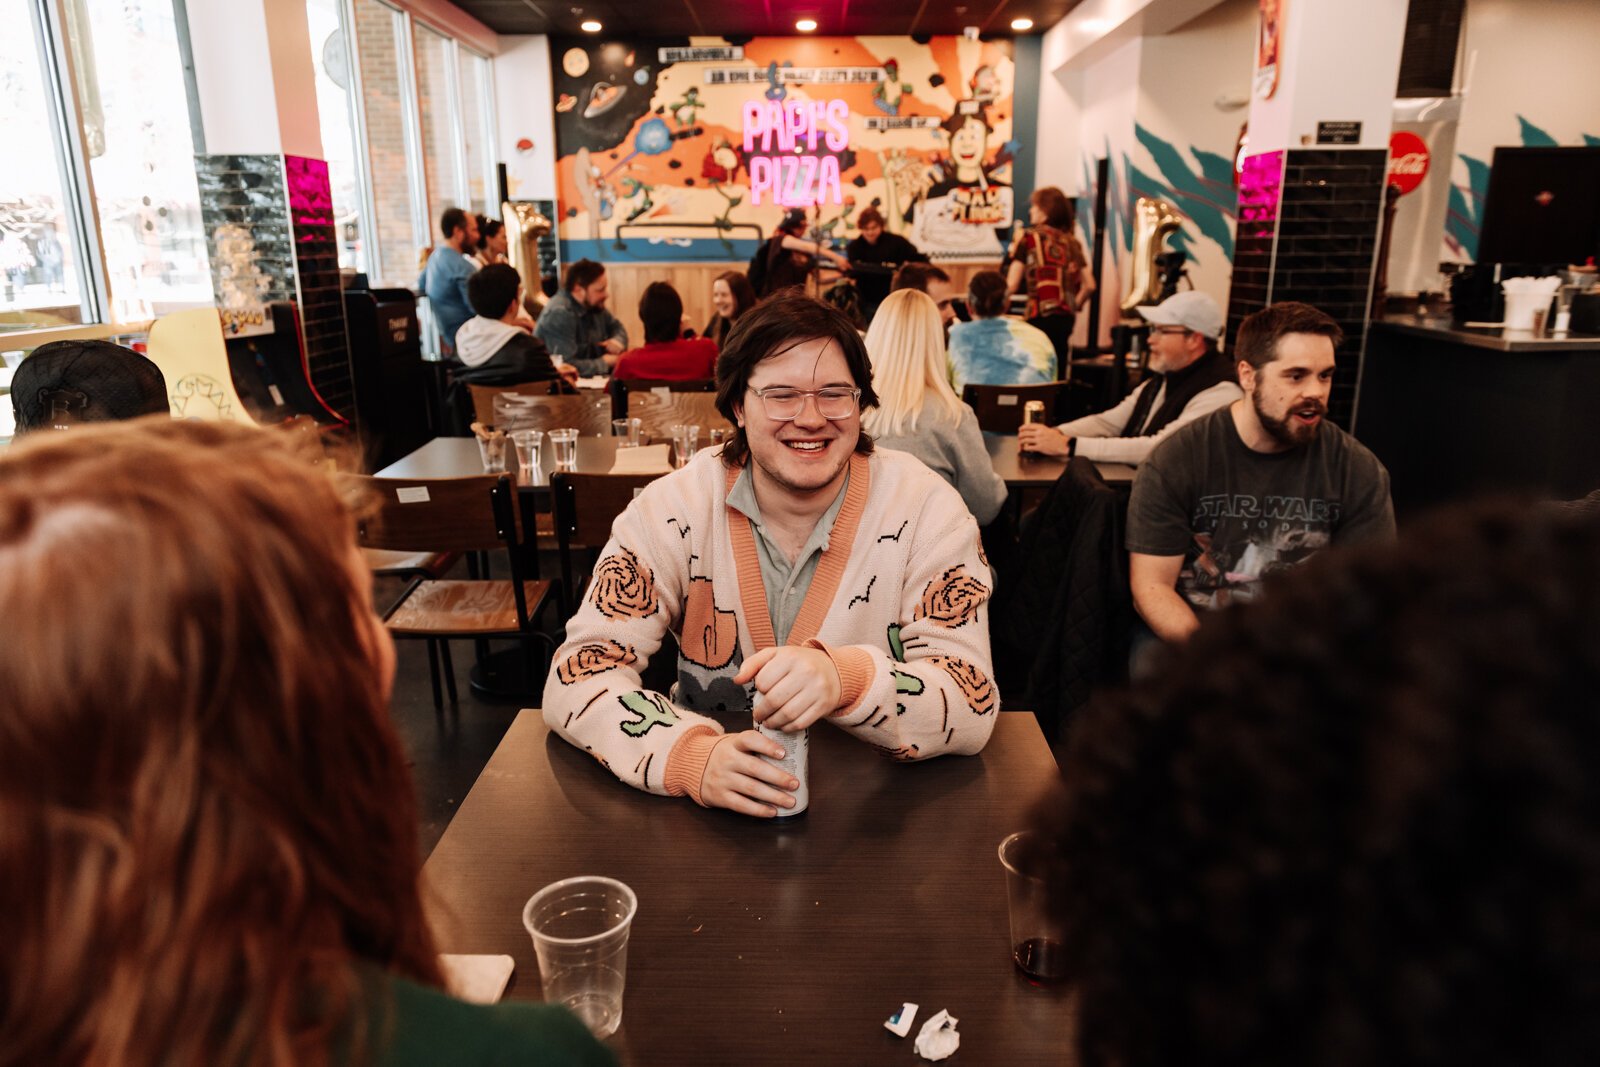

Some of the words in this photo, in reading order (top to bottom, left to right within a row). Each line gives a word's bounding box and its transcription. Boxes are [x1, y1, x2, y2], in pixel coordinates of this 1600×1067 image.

[743, 99, 849, 152] PAPI'S
[750, 155, 842, 206] PIZZA
[1194, 494, 1261, 518] STAR
[1264, 496, 1342, 522] WARS
